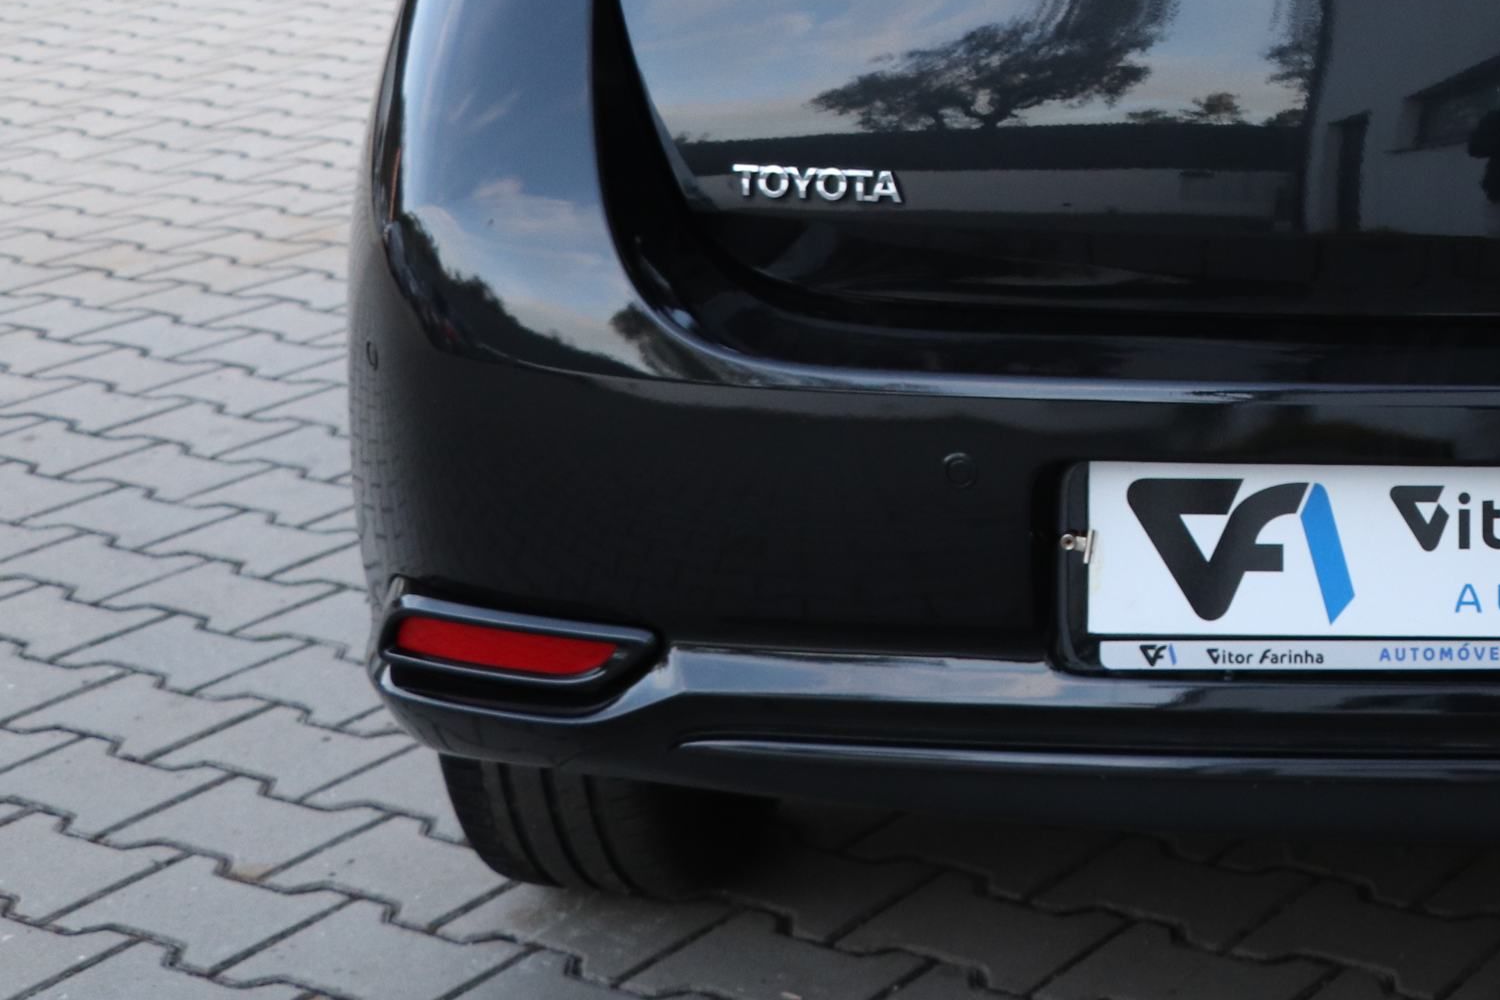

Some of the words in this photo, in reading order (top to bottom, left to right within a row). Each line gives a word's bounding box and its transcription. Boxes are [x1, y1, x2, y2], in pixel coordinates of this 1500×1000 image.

[732, 163, 902, 203] TOYOTA
[1206, 648, 1254, 665] Vitor
[1259, 648, 1325, 665] Farinha
